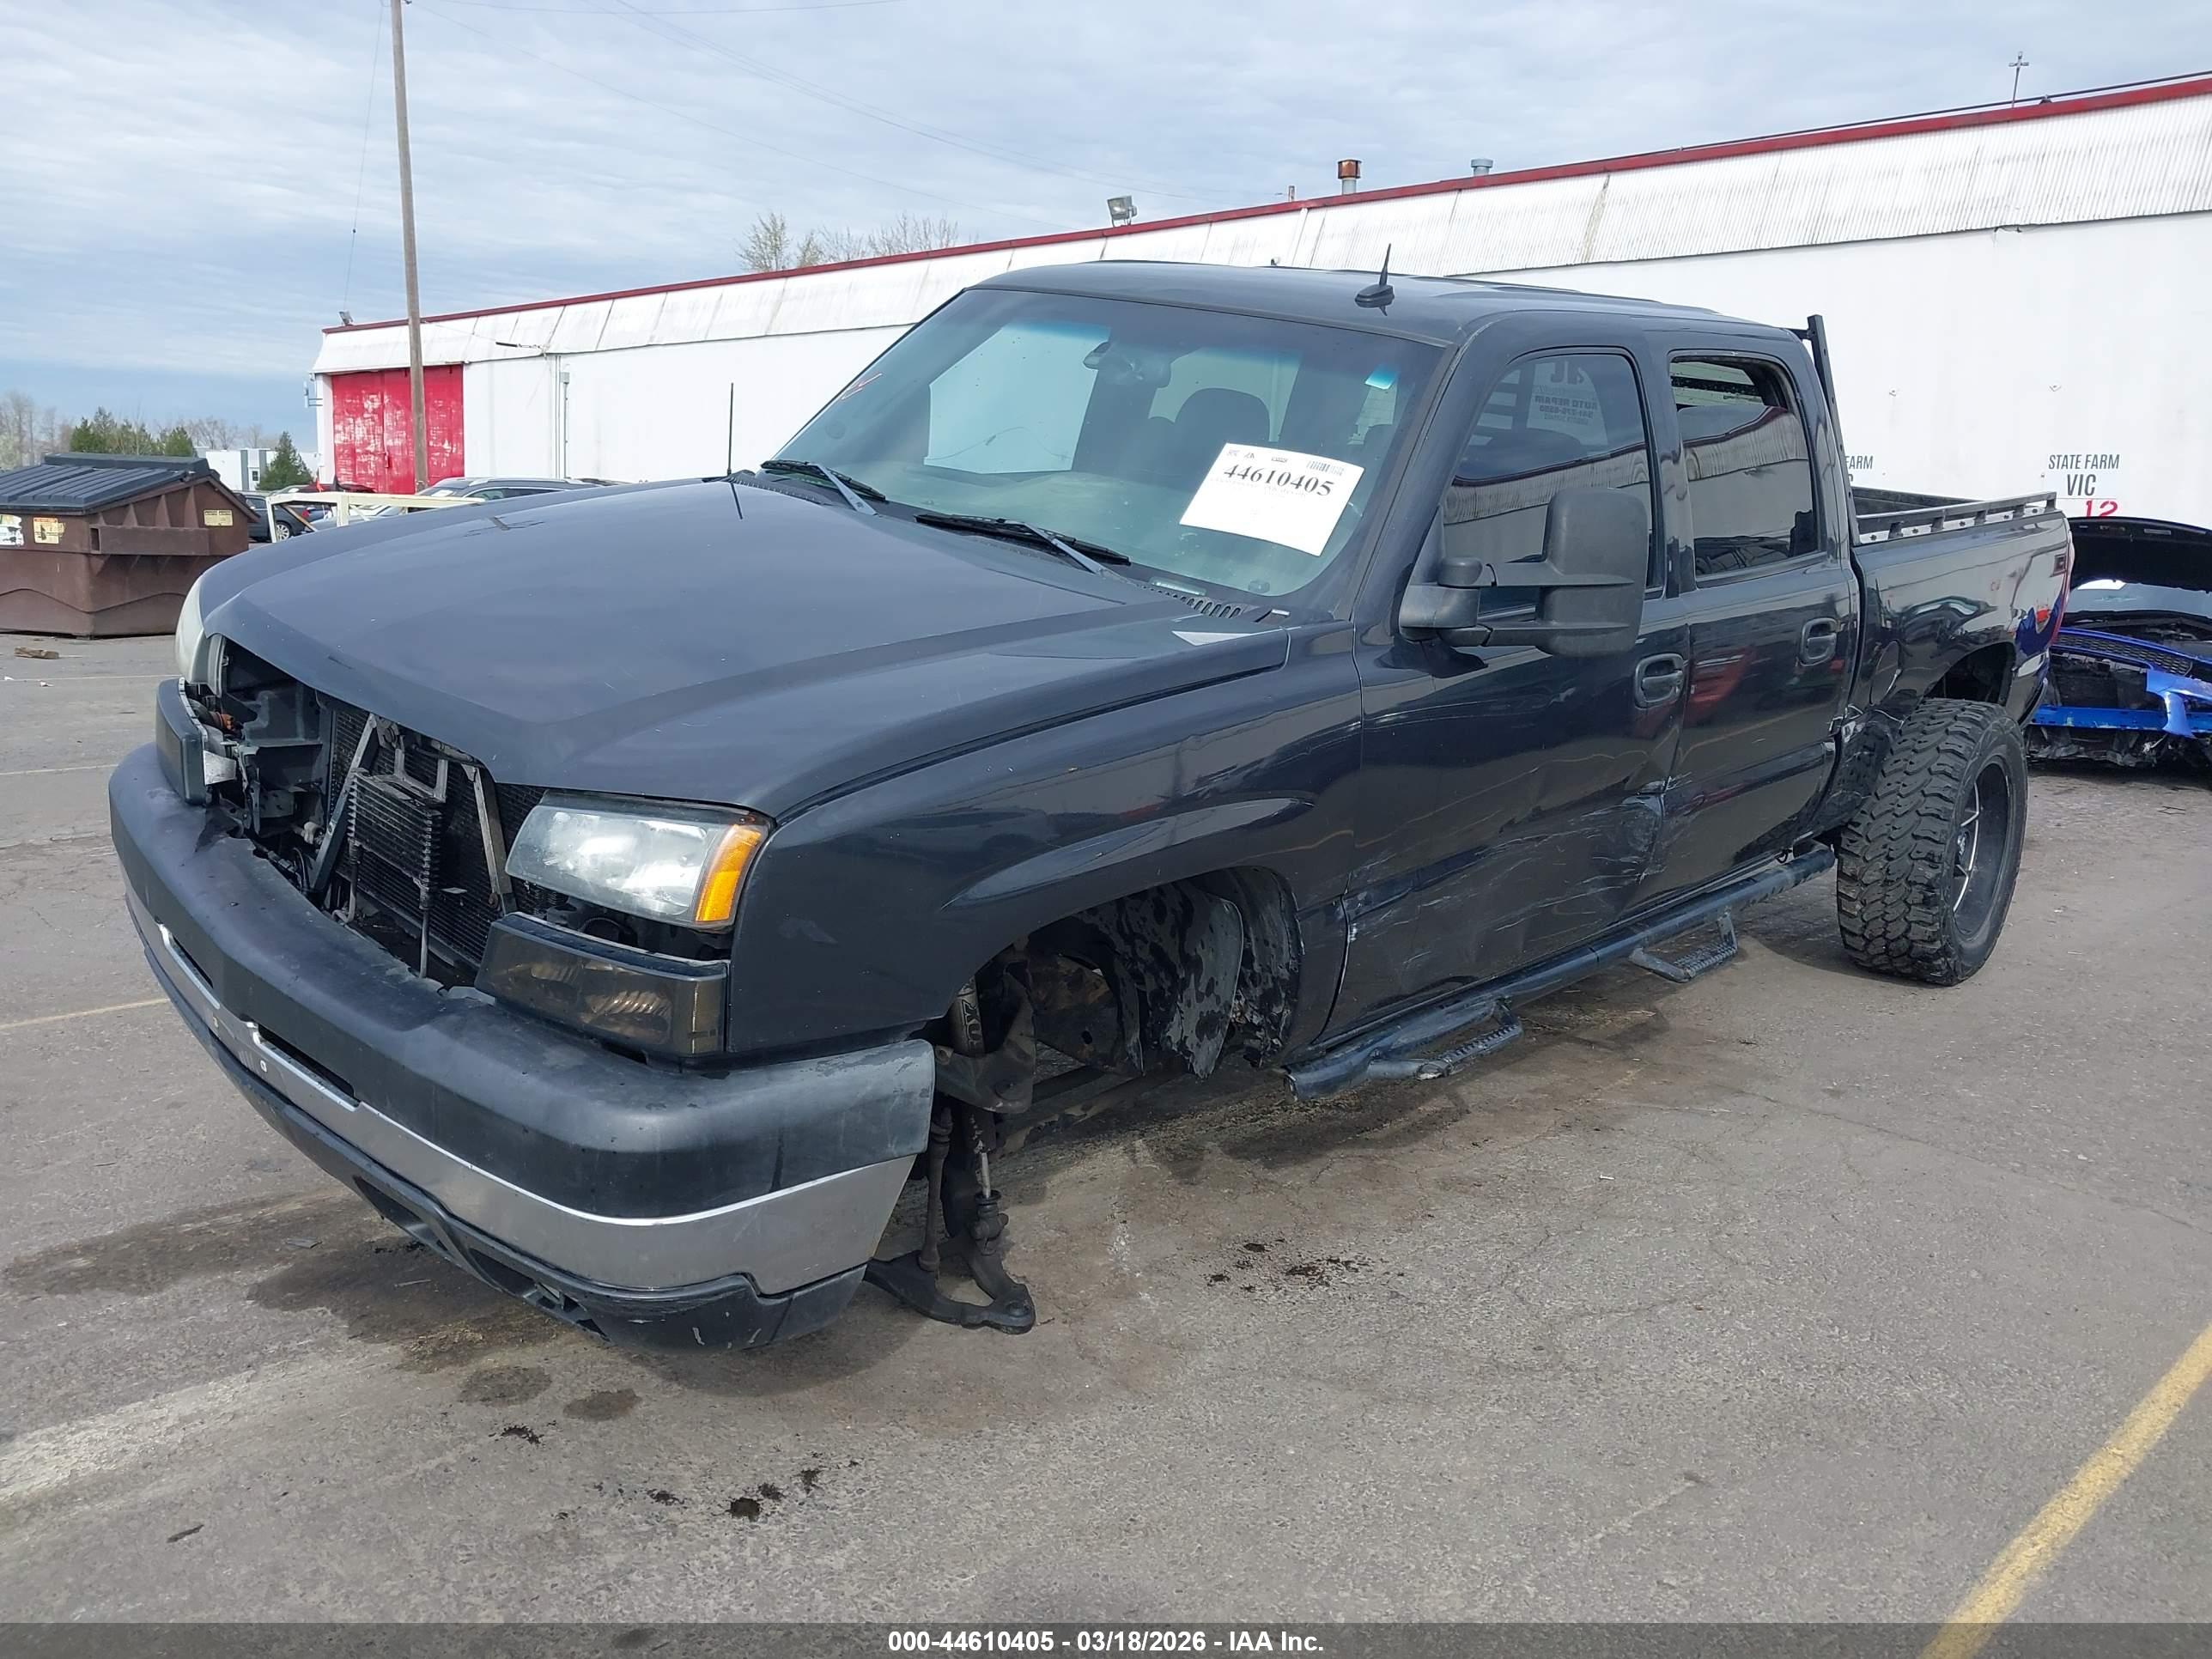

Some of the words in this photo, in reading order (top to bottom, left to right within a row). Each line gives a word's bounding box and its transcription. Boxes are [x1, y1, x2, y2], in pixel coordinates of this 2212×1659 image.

[2048, 454, 2081, 469] STATE
[2084, 454, 2120, 469] FARM
[1224, 465, 1334, 495] 44610405
[2067, 474, 2096, 495] VIC
[2086, 500, 2118, 518] 12
